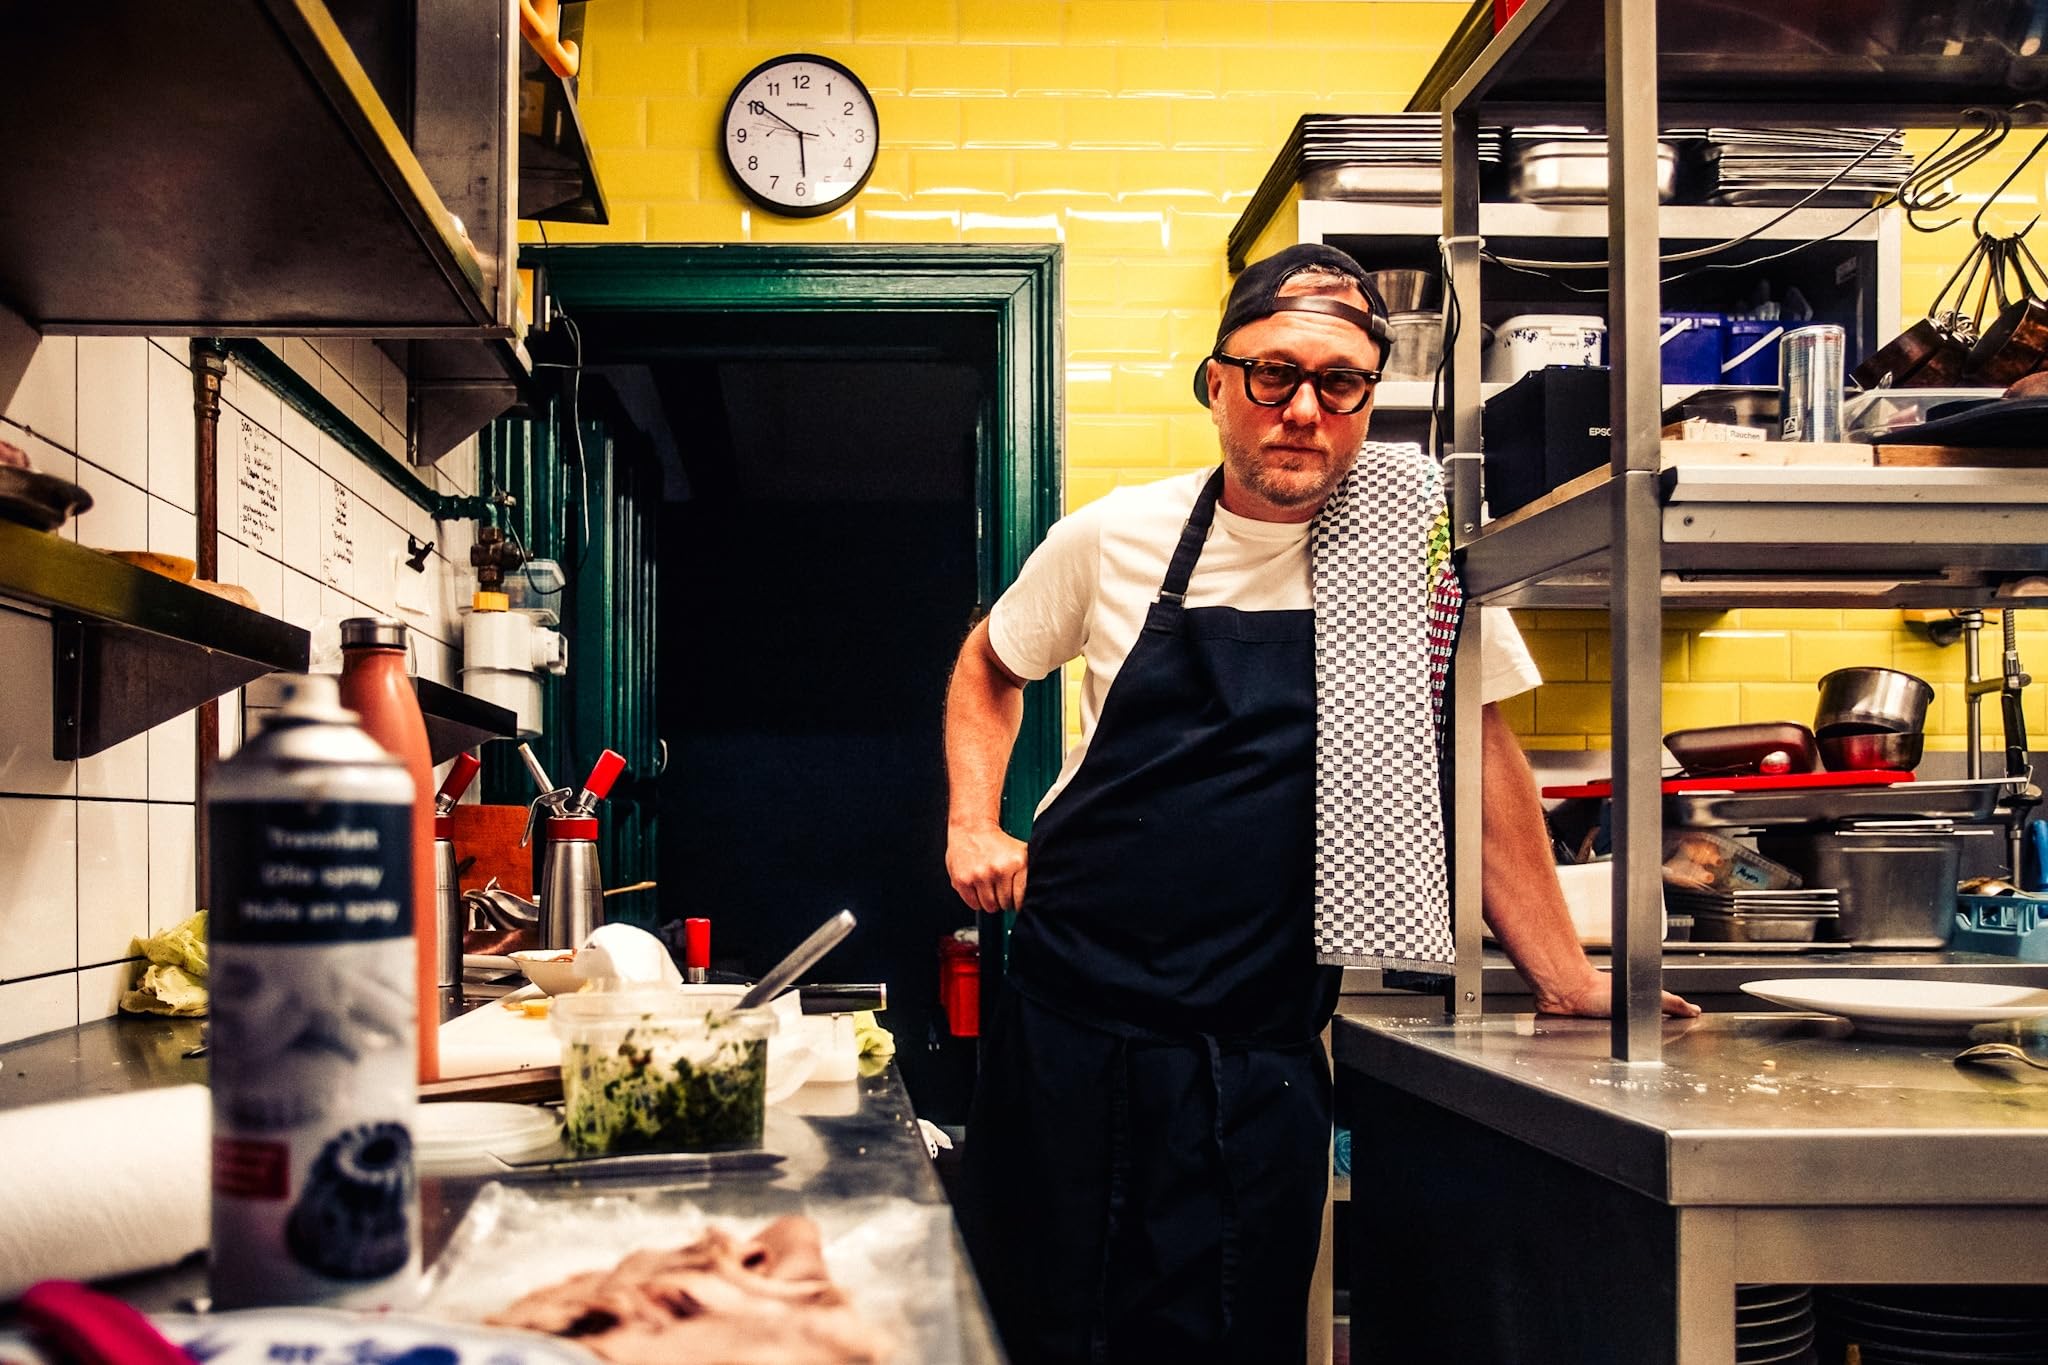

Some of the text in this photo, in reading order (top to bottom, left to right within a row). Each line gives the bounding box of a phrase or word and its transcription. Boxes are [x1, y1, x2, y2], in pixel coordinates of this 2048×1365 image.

[767, 82, 780, 96] 11
[792, 75, 811, 89] 12
[825, 82, 831, 96] 1
[747, 100, 766, 115] 10
[843, 102, 854, 116] 2
[736, 128, 747, 143] 9
[854, 128, 865, 143] 3
[747, 155, 758, 170] 8
[843, 156, 853, 170] 4
[769, 175, 779, 190] 7
[795, 181, 806, 197] 6
[1729, 430, 1761, 440] Rauchen
[321, 866, 384, 890] spray
[345, 900, 399, 924] spray
